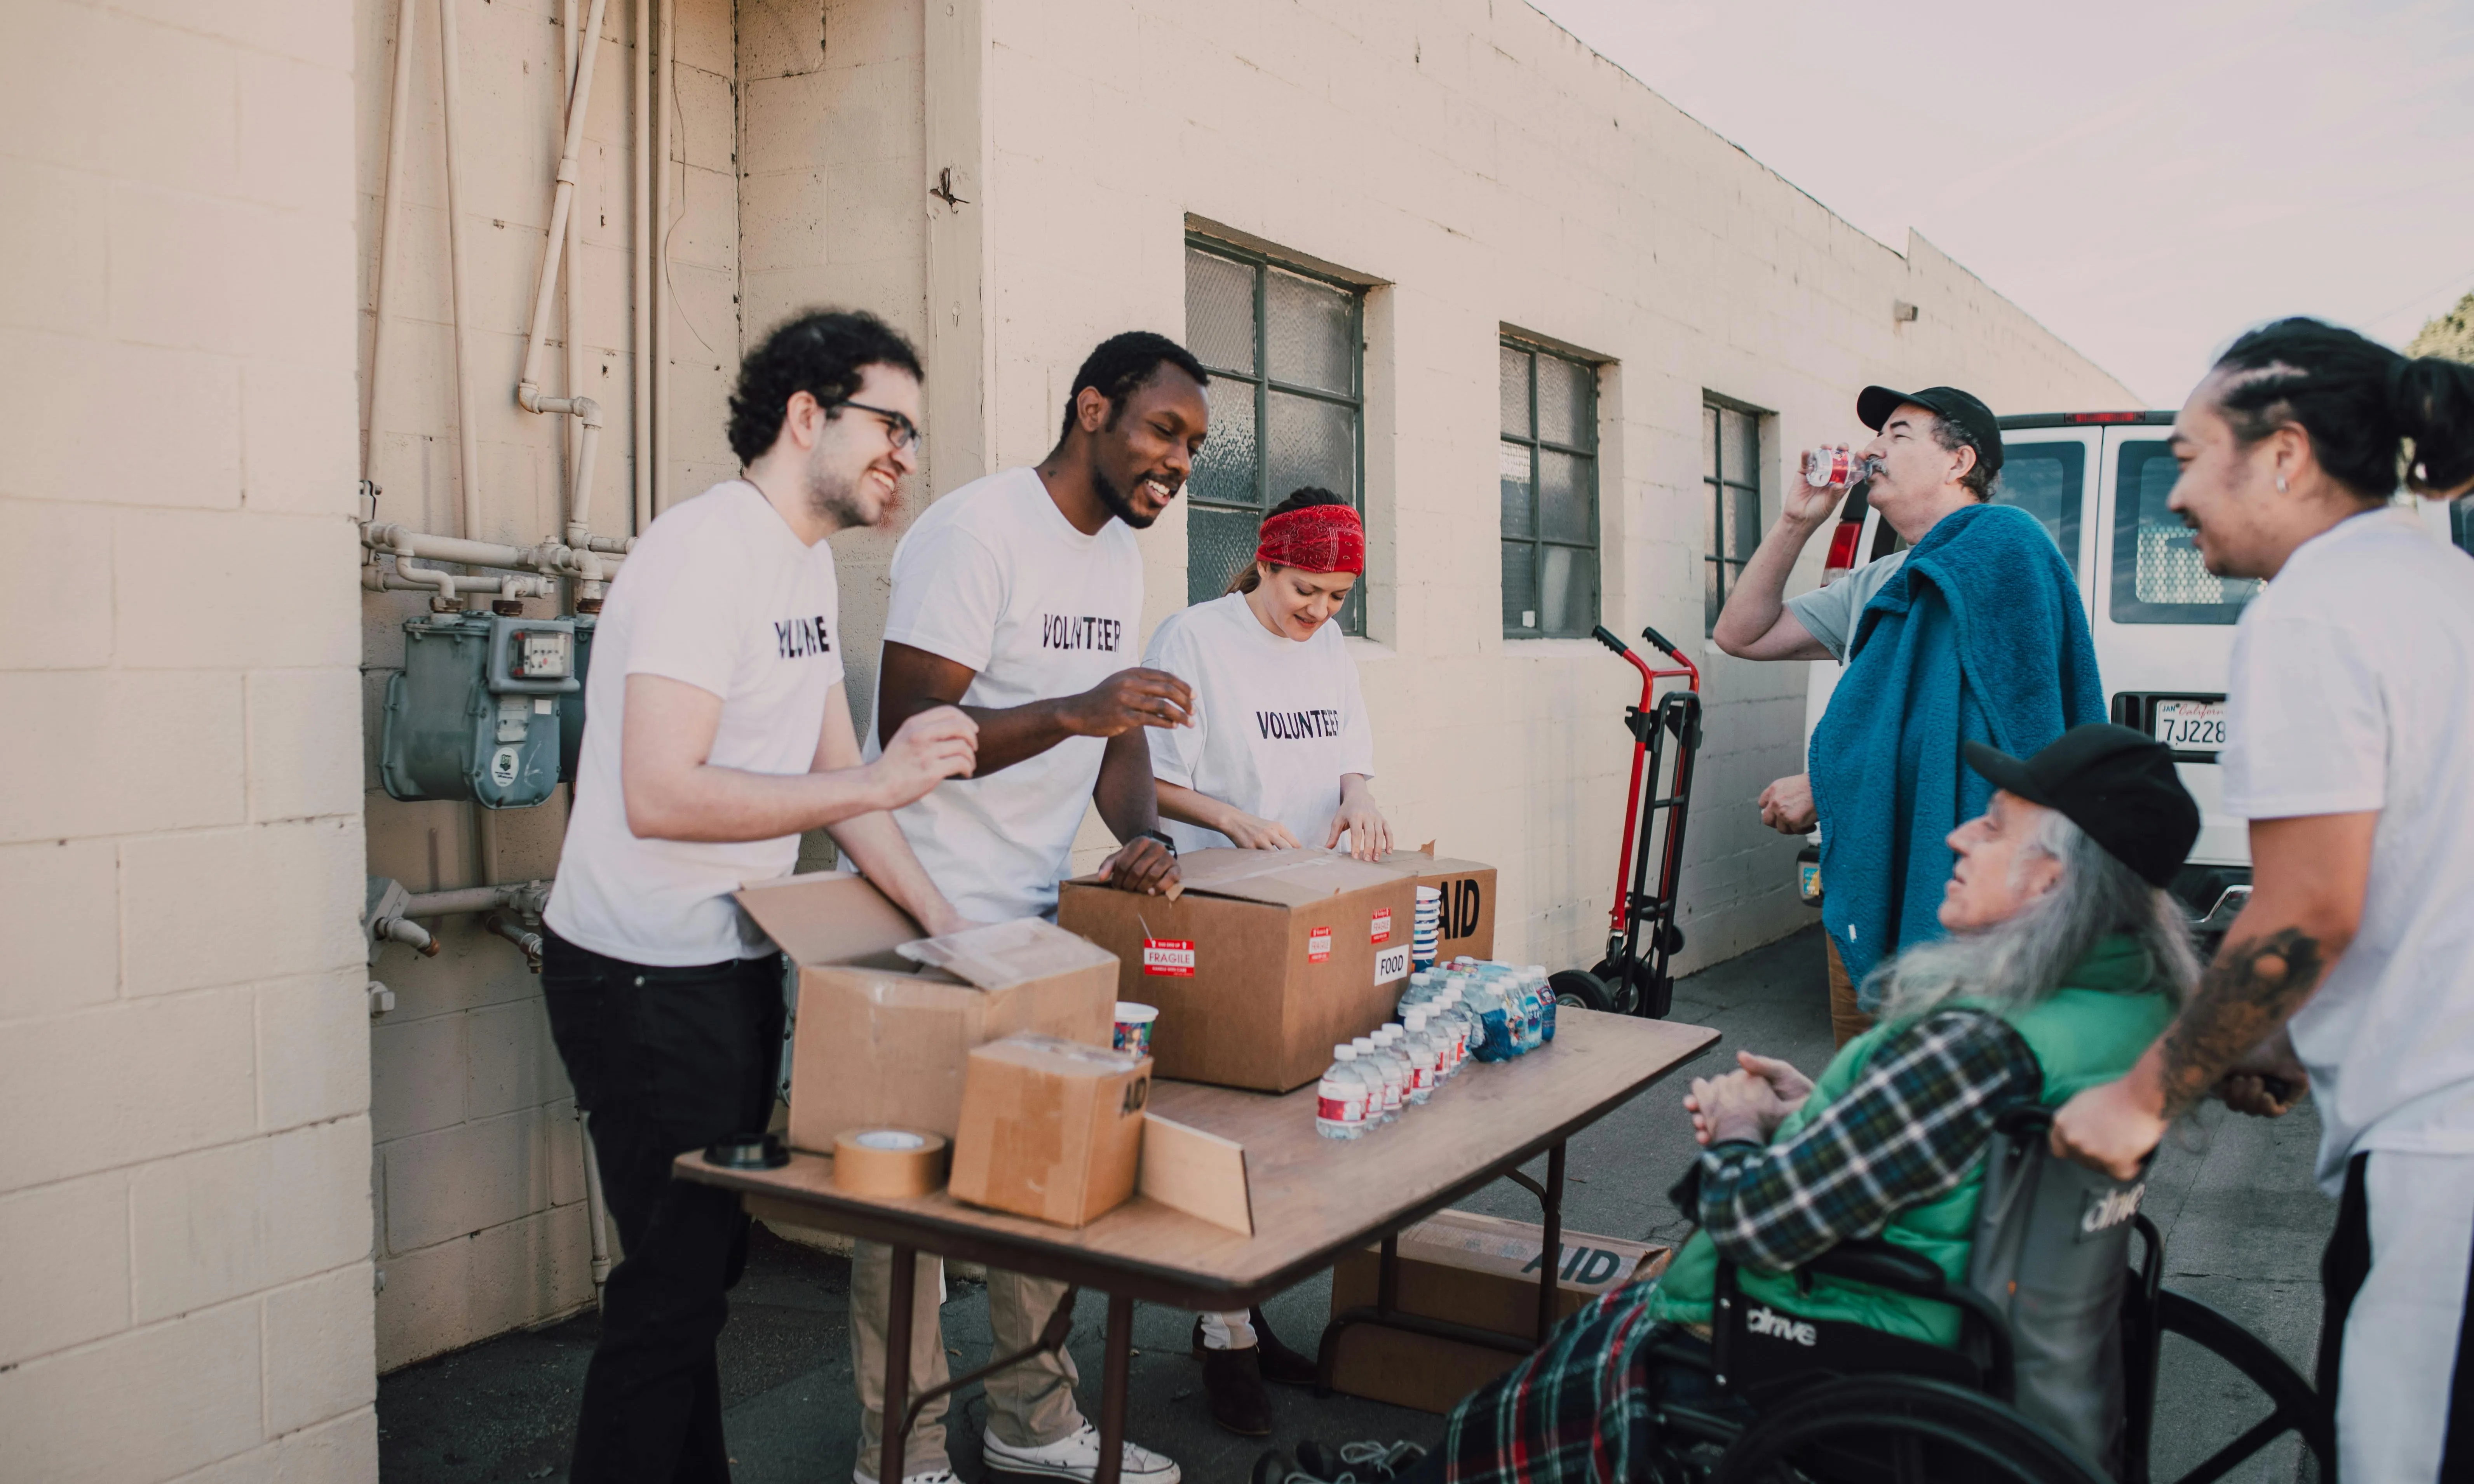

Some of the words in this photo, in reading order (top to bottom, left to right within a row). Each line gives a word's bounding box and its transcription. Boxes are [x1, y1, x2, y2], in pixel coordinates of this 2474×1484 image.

[1043, 613, 1121, 653] VOLNTEER
[2179, 704, 2223, 719] Californ
[2164, 719, 2226, 743] 7J228
[1437, 879, 1480, 940] AID
[1149, 951, 1190, 964] FRAGILE
[1380, 955, 1403, 976] FOOD
[1746, 1306, 1817, 1347] drive
